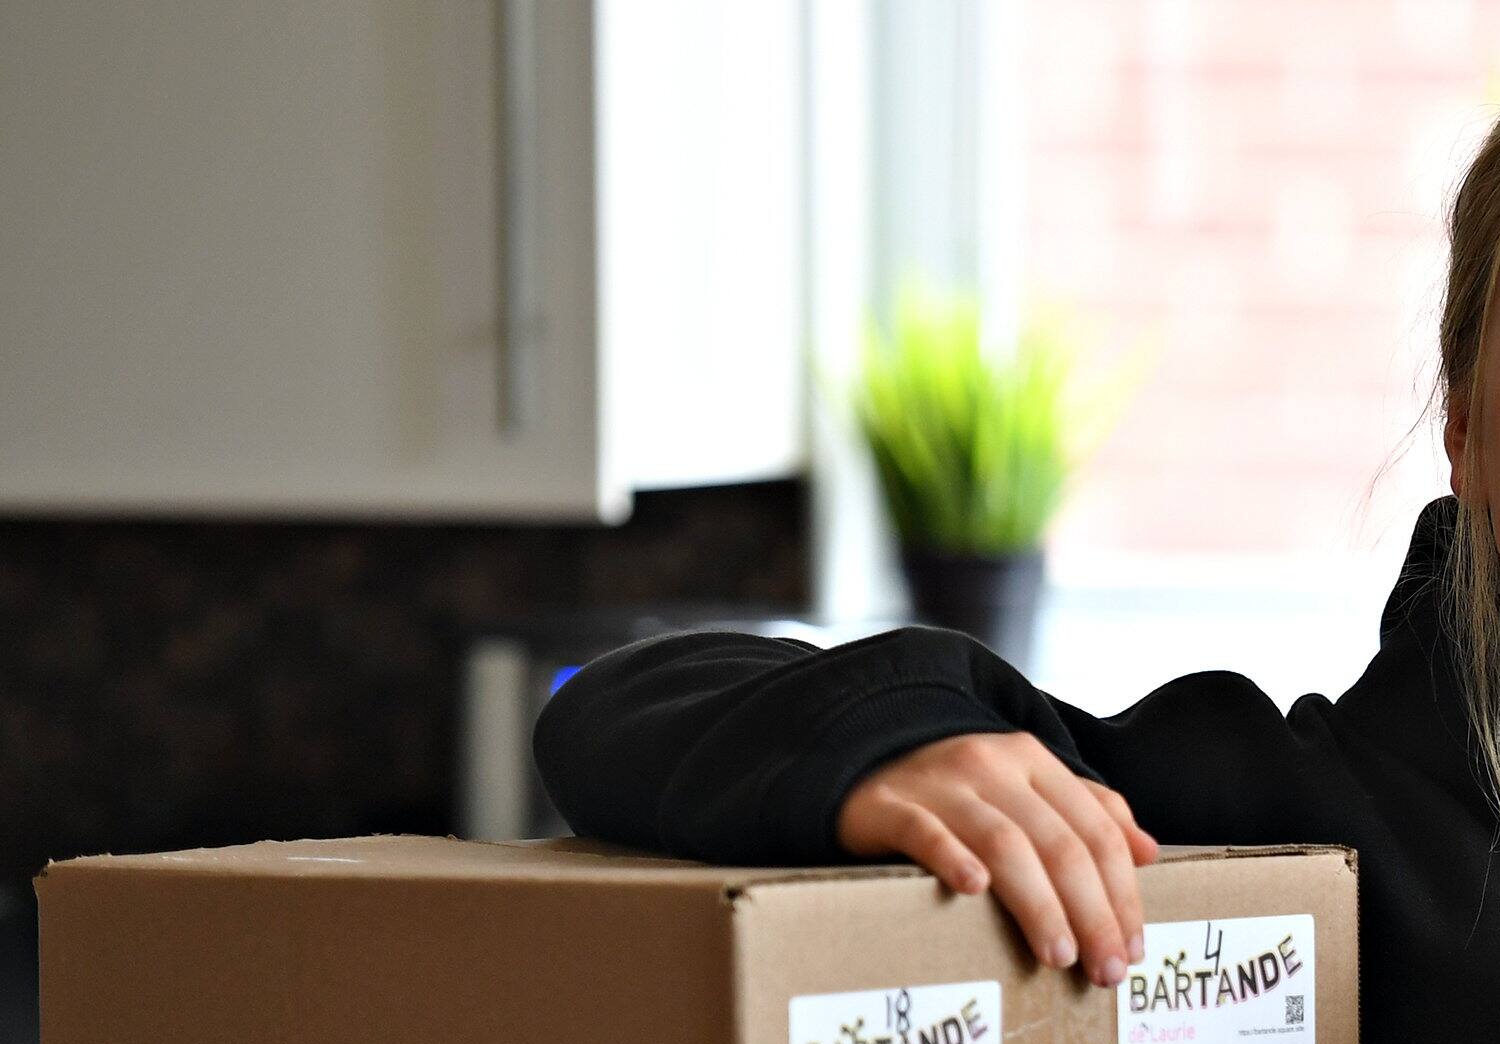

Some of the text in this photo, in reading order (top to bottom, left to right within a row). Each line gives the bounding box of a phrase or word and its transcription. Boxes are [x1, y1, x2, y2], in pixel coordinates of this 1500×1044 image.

[1130, 935, 1304, 1012] BARTANDE
[1204, 922, 1222, 975] 4
[886, 989, 911, 1035] 18
